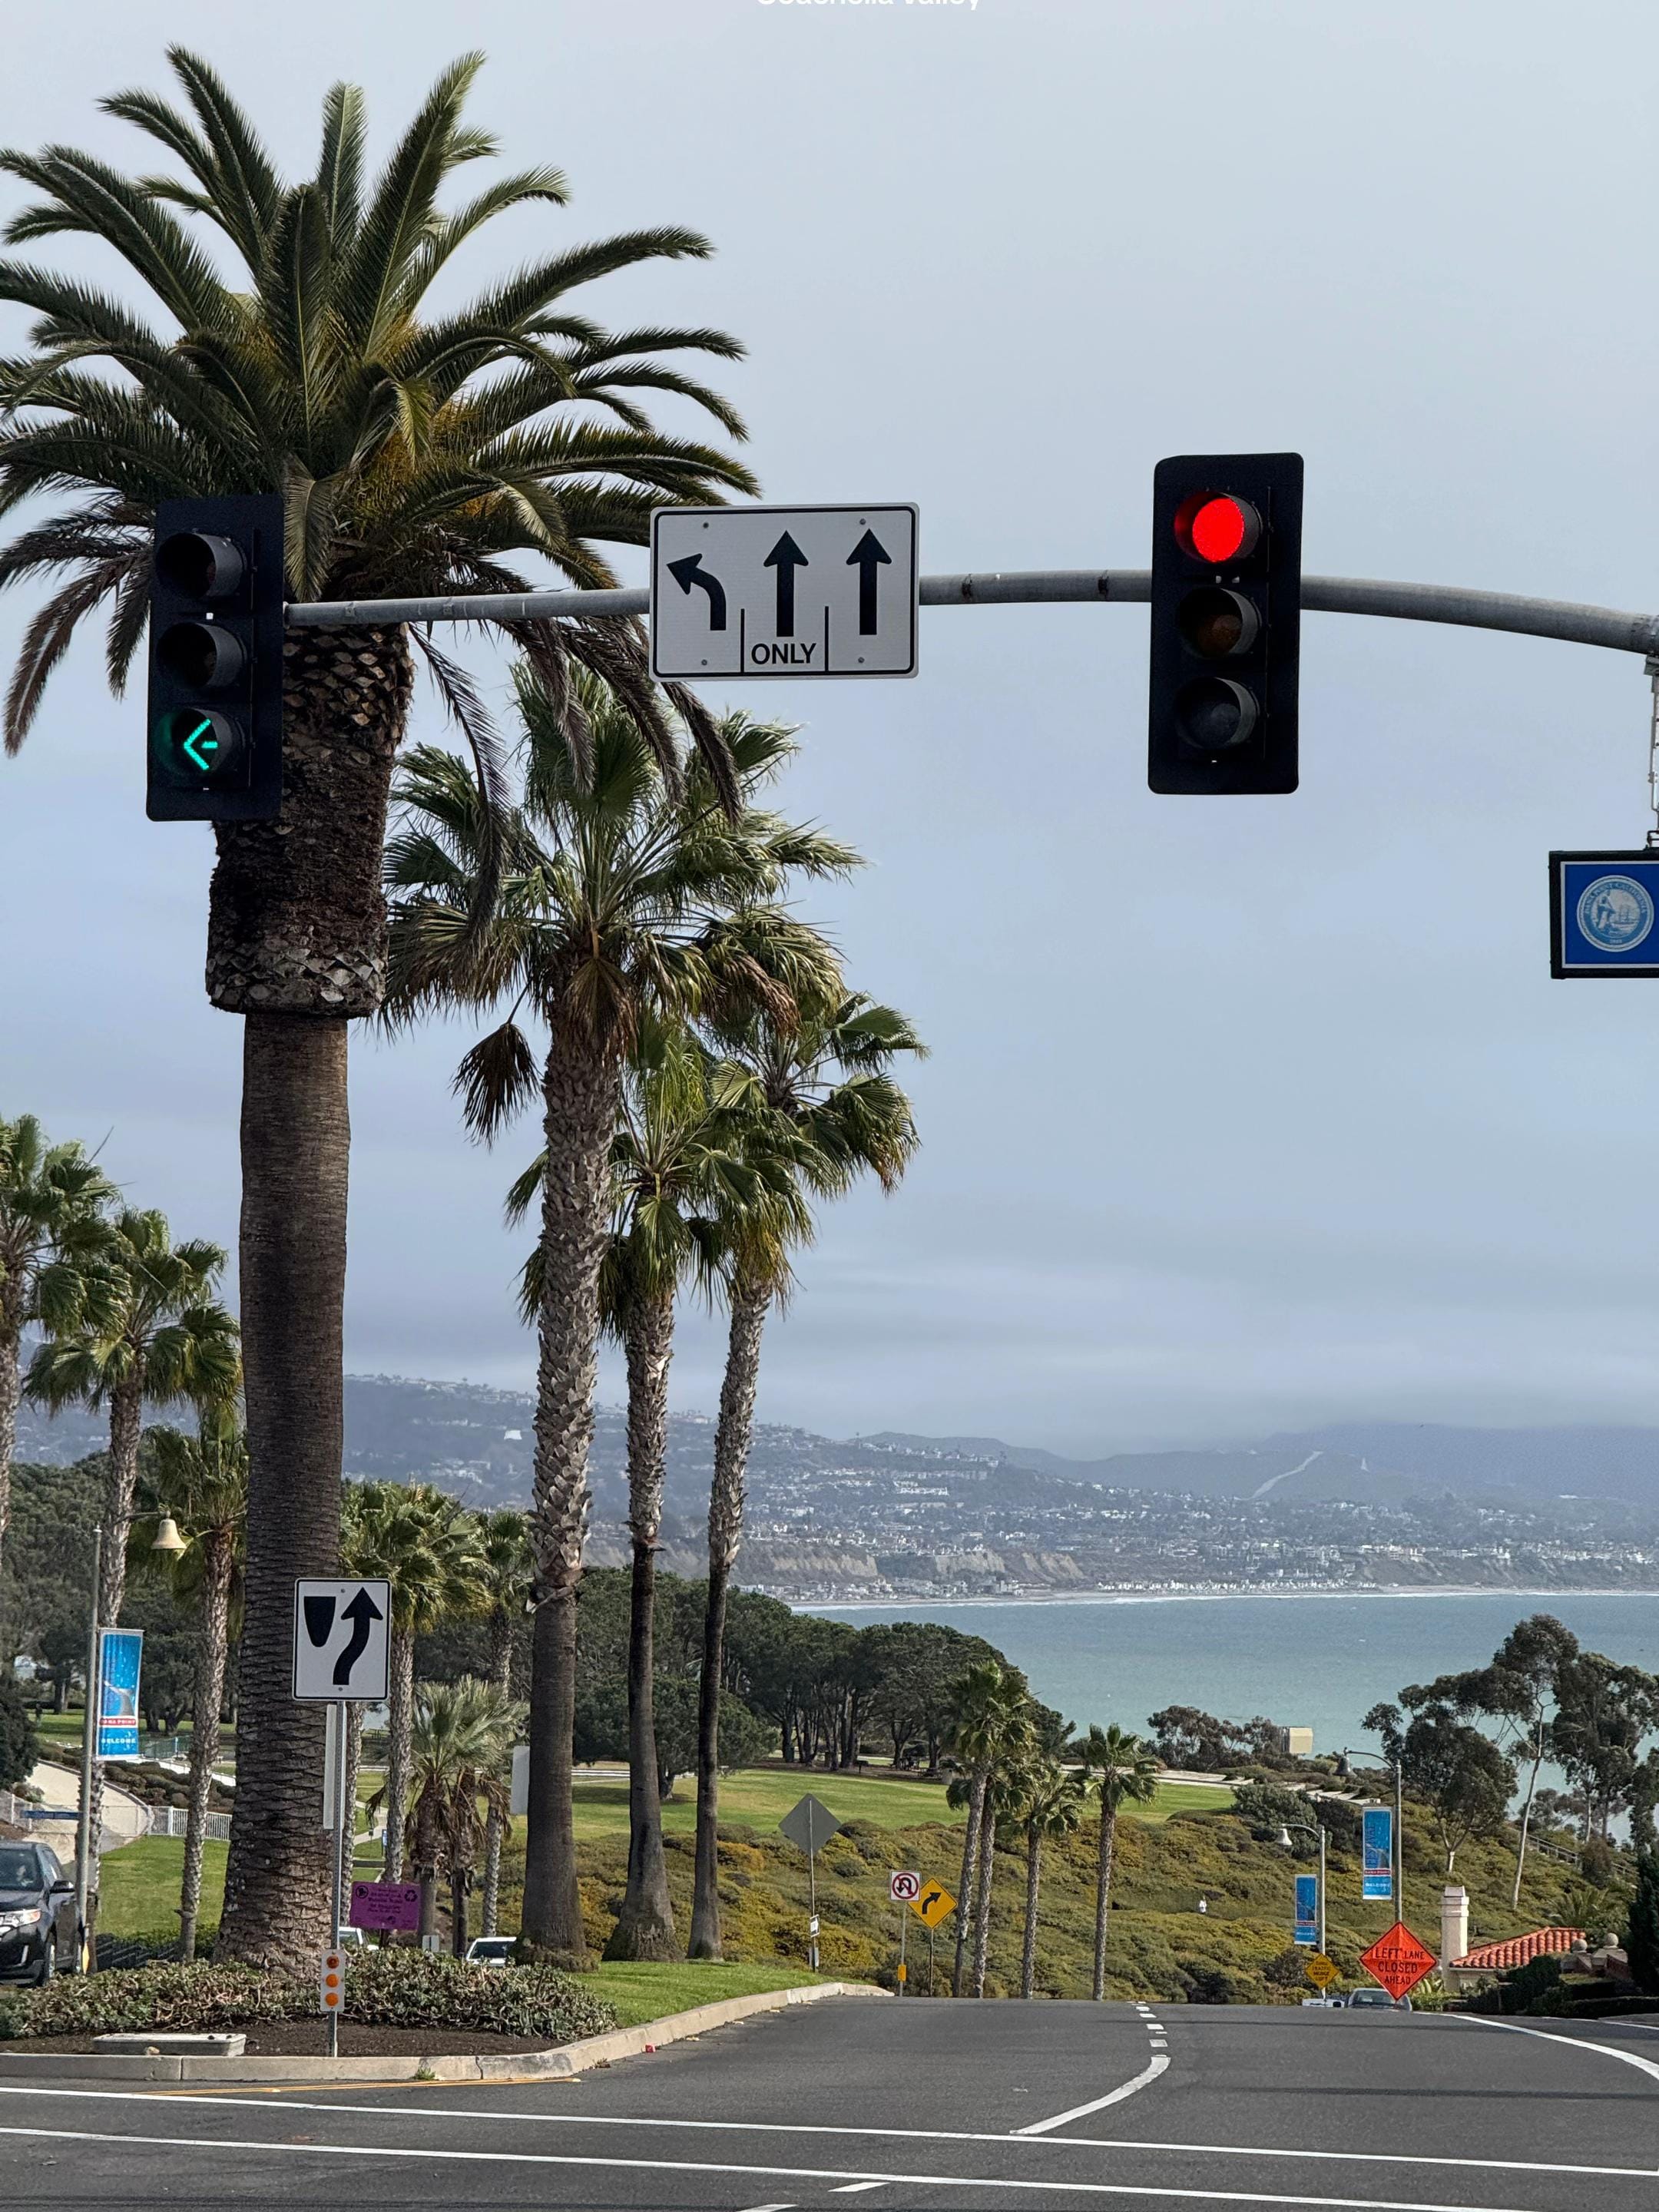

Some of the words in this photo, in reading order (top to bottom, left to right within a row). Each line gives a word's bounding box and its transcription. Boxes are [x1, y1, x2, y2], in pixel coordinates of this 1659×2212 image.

[751, 643, 816, 665] ONLY
[1376, 1948, 1402, 1959] LEFT
[1405, 1951, 1425, 1960] LANE
[1378, 1961, 1418, 1974] CLOSED
[1385, 1975, 1411, 1985] AHEAD
